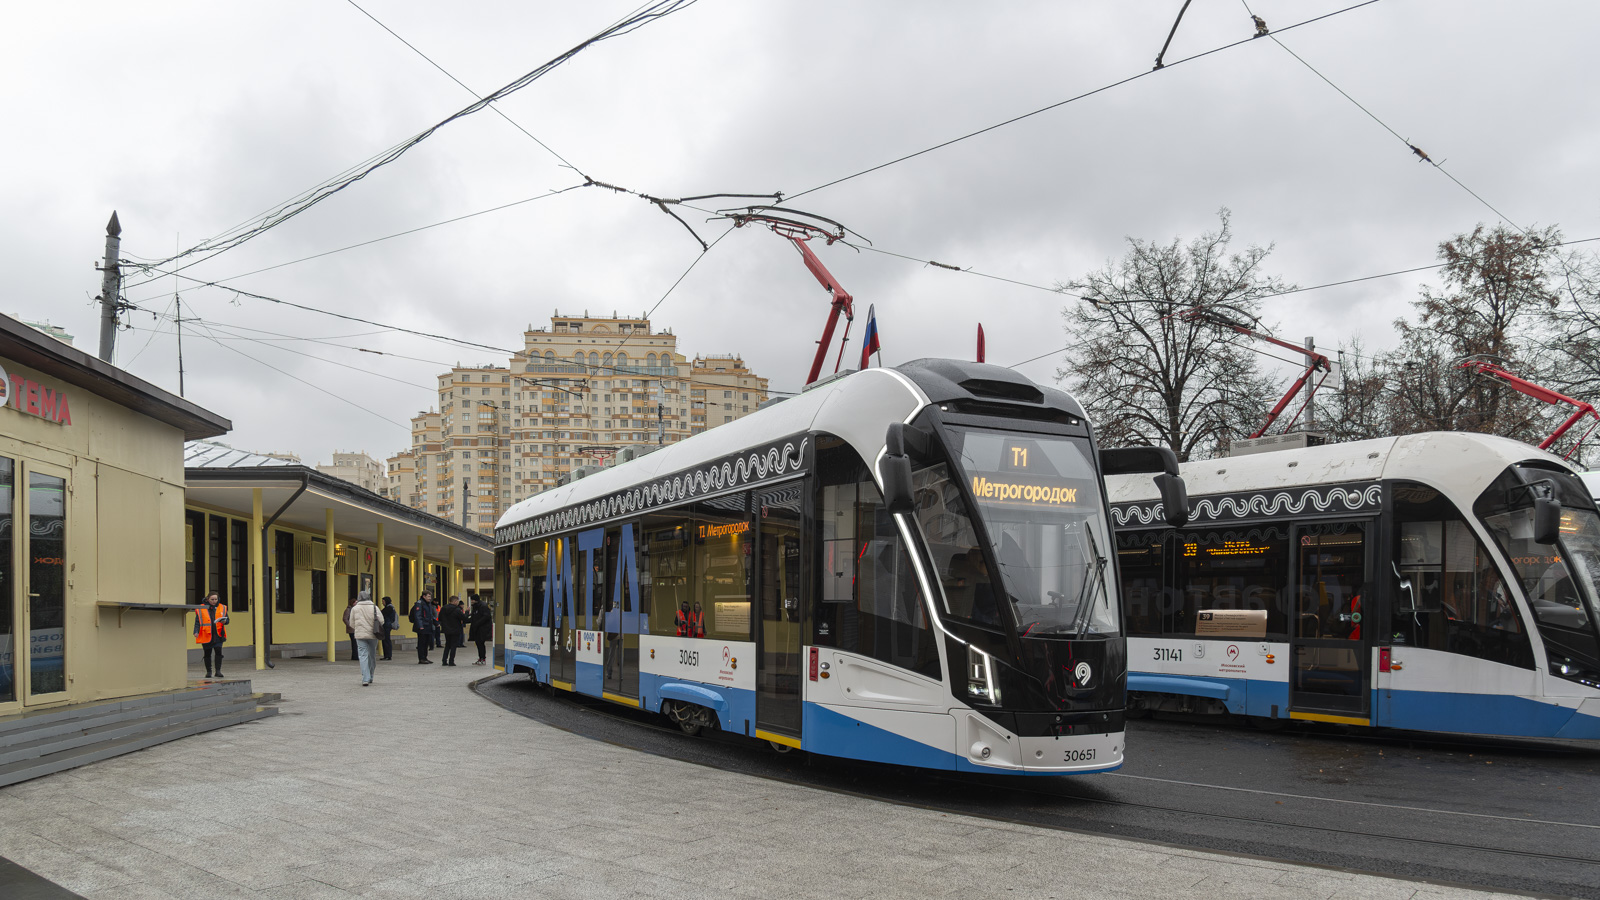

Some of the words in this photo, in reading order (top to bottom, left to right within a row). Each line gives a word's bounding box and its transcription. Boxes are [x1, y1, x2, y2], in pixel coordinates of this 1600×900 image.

[10, 373, 72, 426] ТЕМА
[1011, 447, 1028, 467] Т1
[972, 476, 1077, 504] Метрогородок
[706, 521, 750, 538] Метрогородок
[679, 649, 699, 667] 30651
[1153, 647, 1183, 662] 31141
[1063, 749, 1096, 762] 30651
